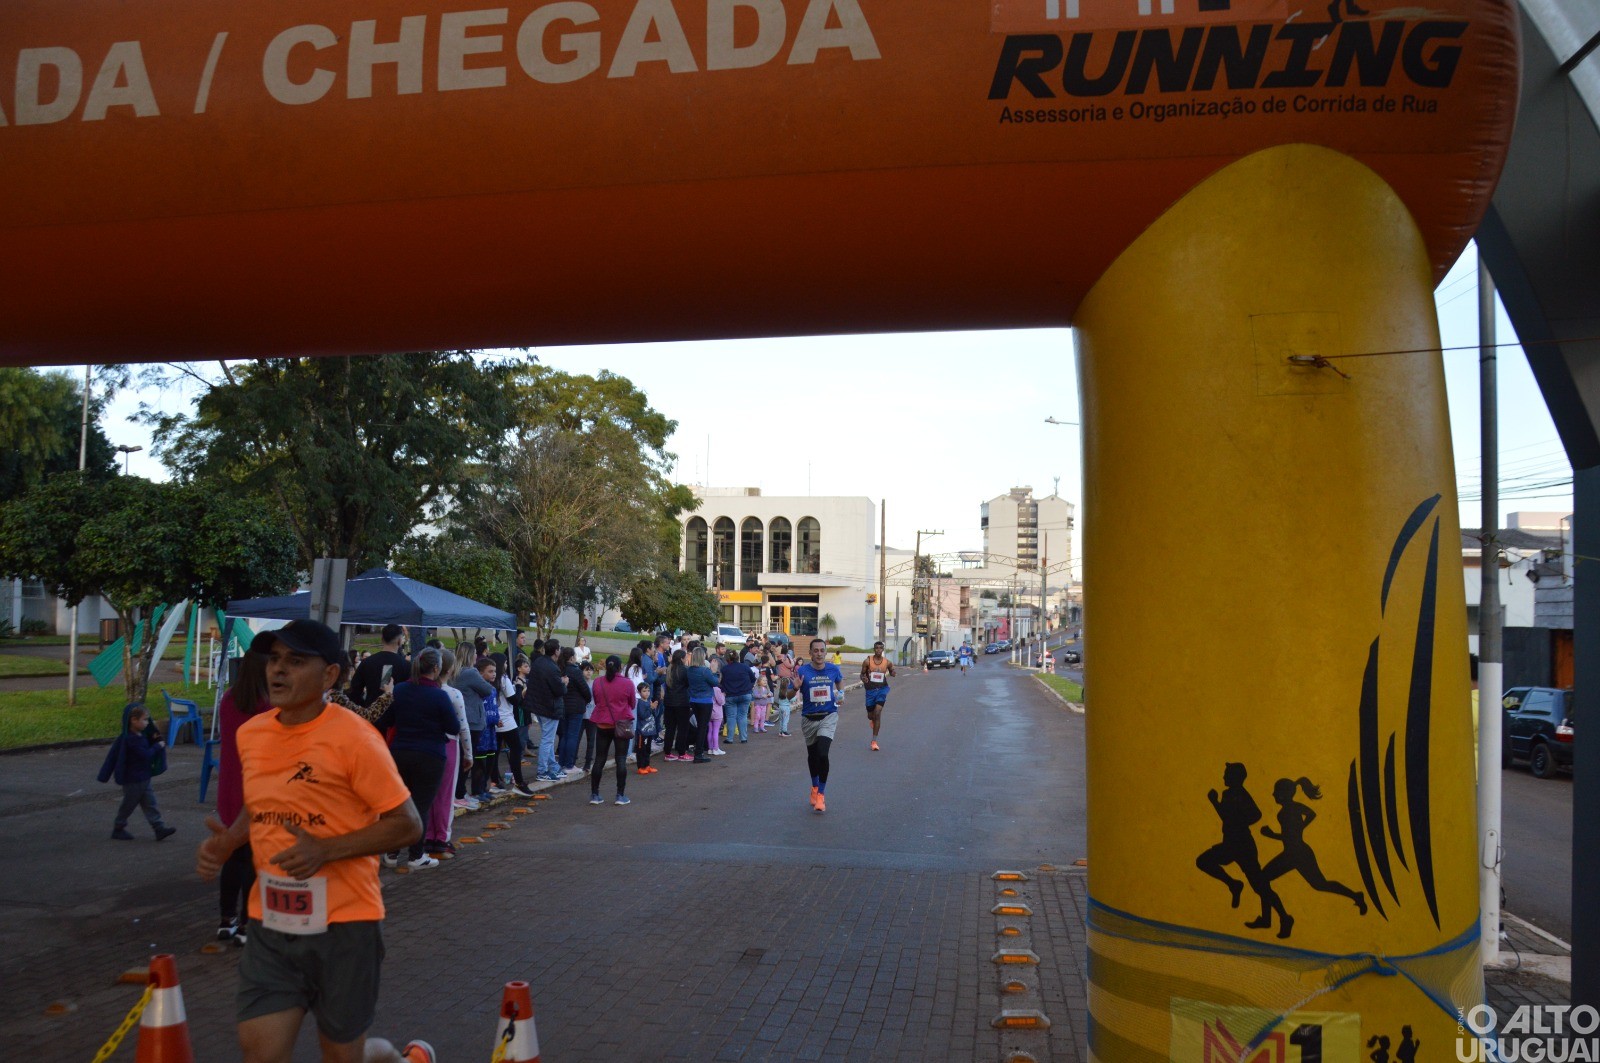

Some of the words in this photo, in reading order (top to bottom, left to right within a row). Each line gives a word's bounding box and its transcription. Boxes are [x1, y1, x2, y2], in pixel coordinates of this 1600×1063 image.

[0, 41, 160, 127] DA
[194, 31, 229, 114] /
[262, 0, 882, 105] CHEGADA
[987, 21, 1469, 100] RUNNING
[1000, 105, 1107, 123] Assessoria
[1113, 108, 1124, 120] e
[1129, 96, 1256, 122] Organização
[1262, 96, 1286, 113] de
[1293, 95, 1367, 113] Corrida
[1372, 95, 1396, 112] de
[1402, 95, 1438, 113] Rua
[271, 892, 307, 912] 115
